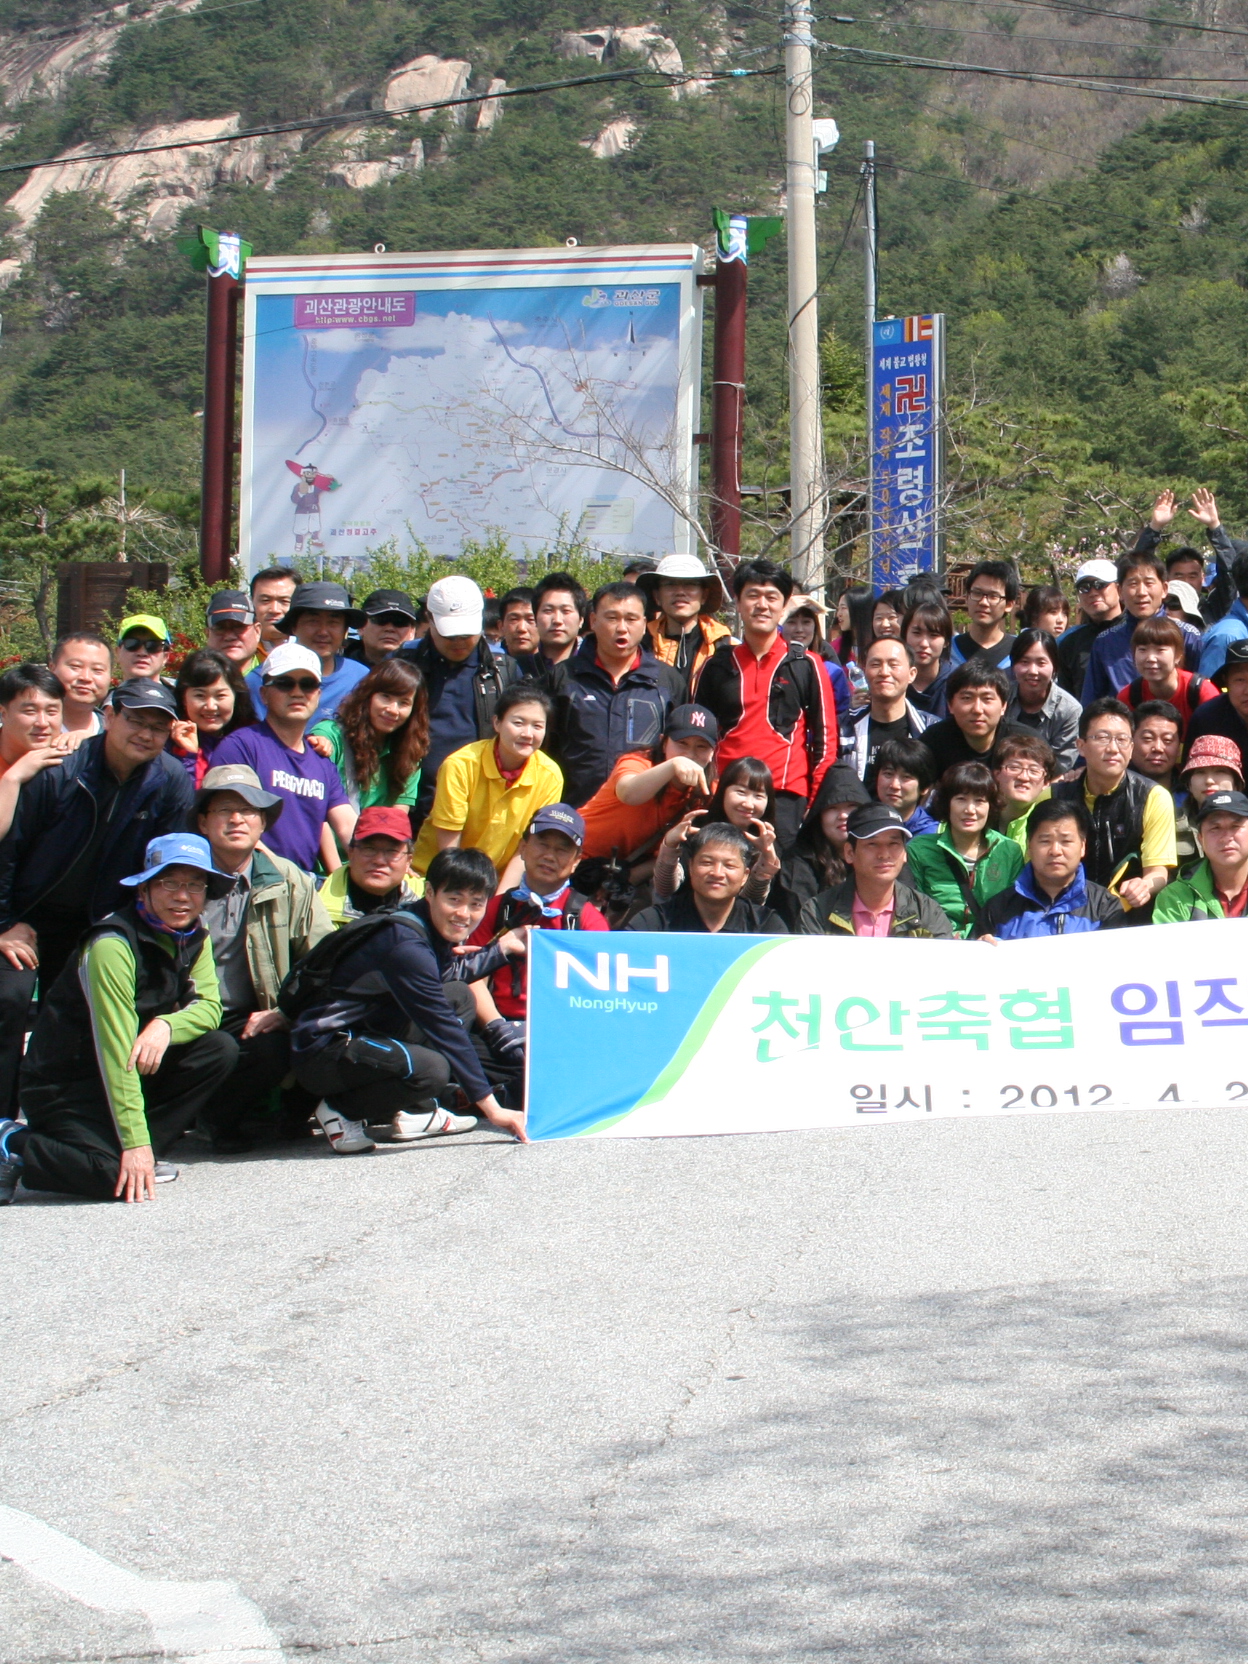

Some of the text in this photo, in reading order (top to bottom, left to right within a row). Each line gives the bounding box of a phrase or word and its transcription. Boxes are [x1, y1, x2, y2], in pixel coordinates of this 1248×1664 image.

[304, 296, 406, 315] 괴산관광안내도
[879, 356, 891, 371] 세계
[894, 355, 906, 370] 불교
[691, 711, 706, 728] NY
[555, 950, 670, 993] NH
[569, 995, 659, 1015] NongHyup
[751, 986, 1076, 1063] 천안축협
[849, 1083, 933, 1114] 일시
